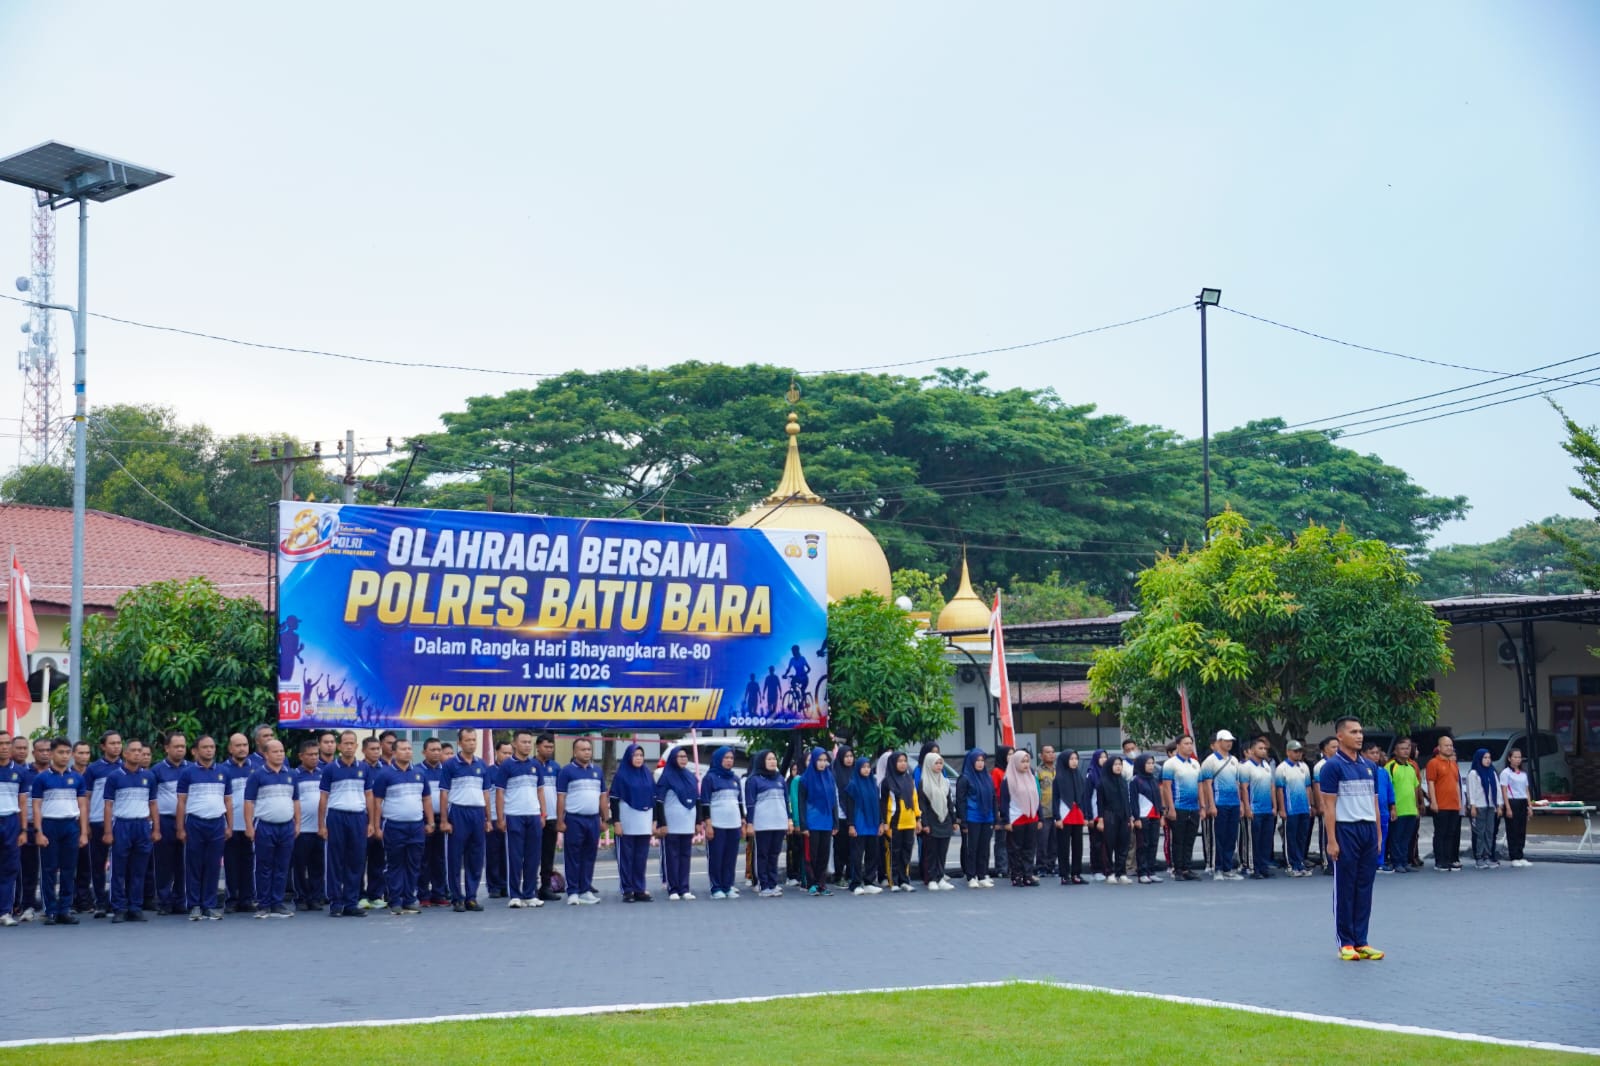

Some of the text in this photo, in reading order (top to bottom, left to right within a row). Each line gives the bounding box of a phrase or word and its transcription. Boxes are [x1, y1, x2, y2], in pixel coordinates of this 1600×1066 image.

[330, 536, 363, 549] POLRI
[387, 526, 728, 579] OLAHRAGA BERSAMA
[344, 569, 771, 634] POLRES BATU BARA
[414, 637, 711, 662] Dalam Rangka Hari Bhayangkara Ke-80
[522, 663, 611, 680] 1 Juli 2026
[430, 693, 700, 714] “POLRI UNTUK MASYARAKAT”
